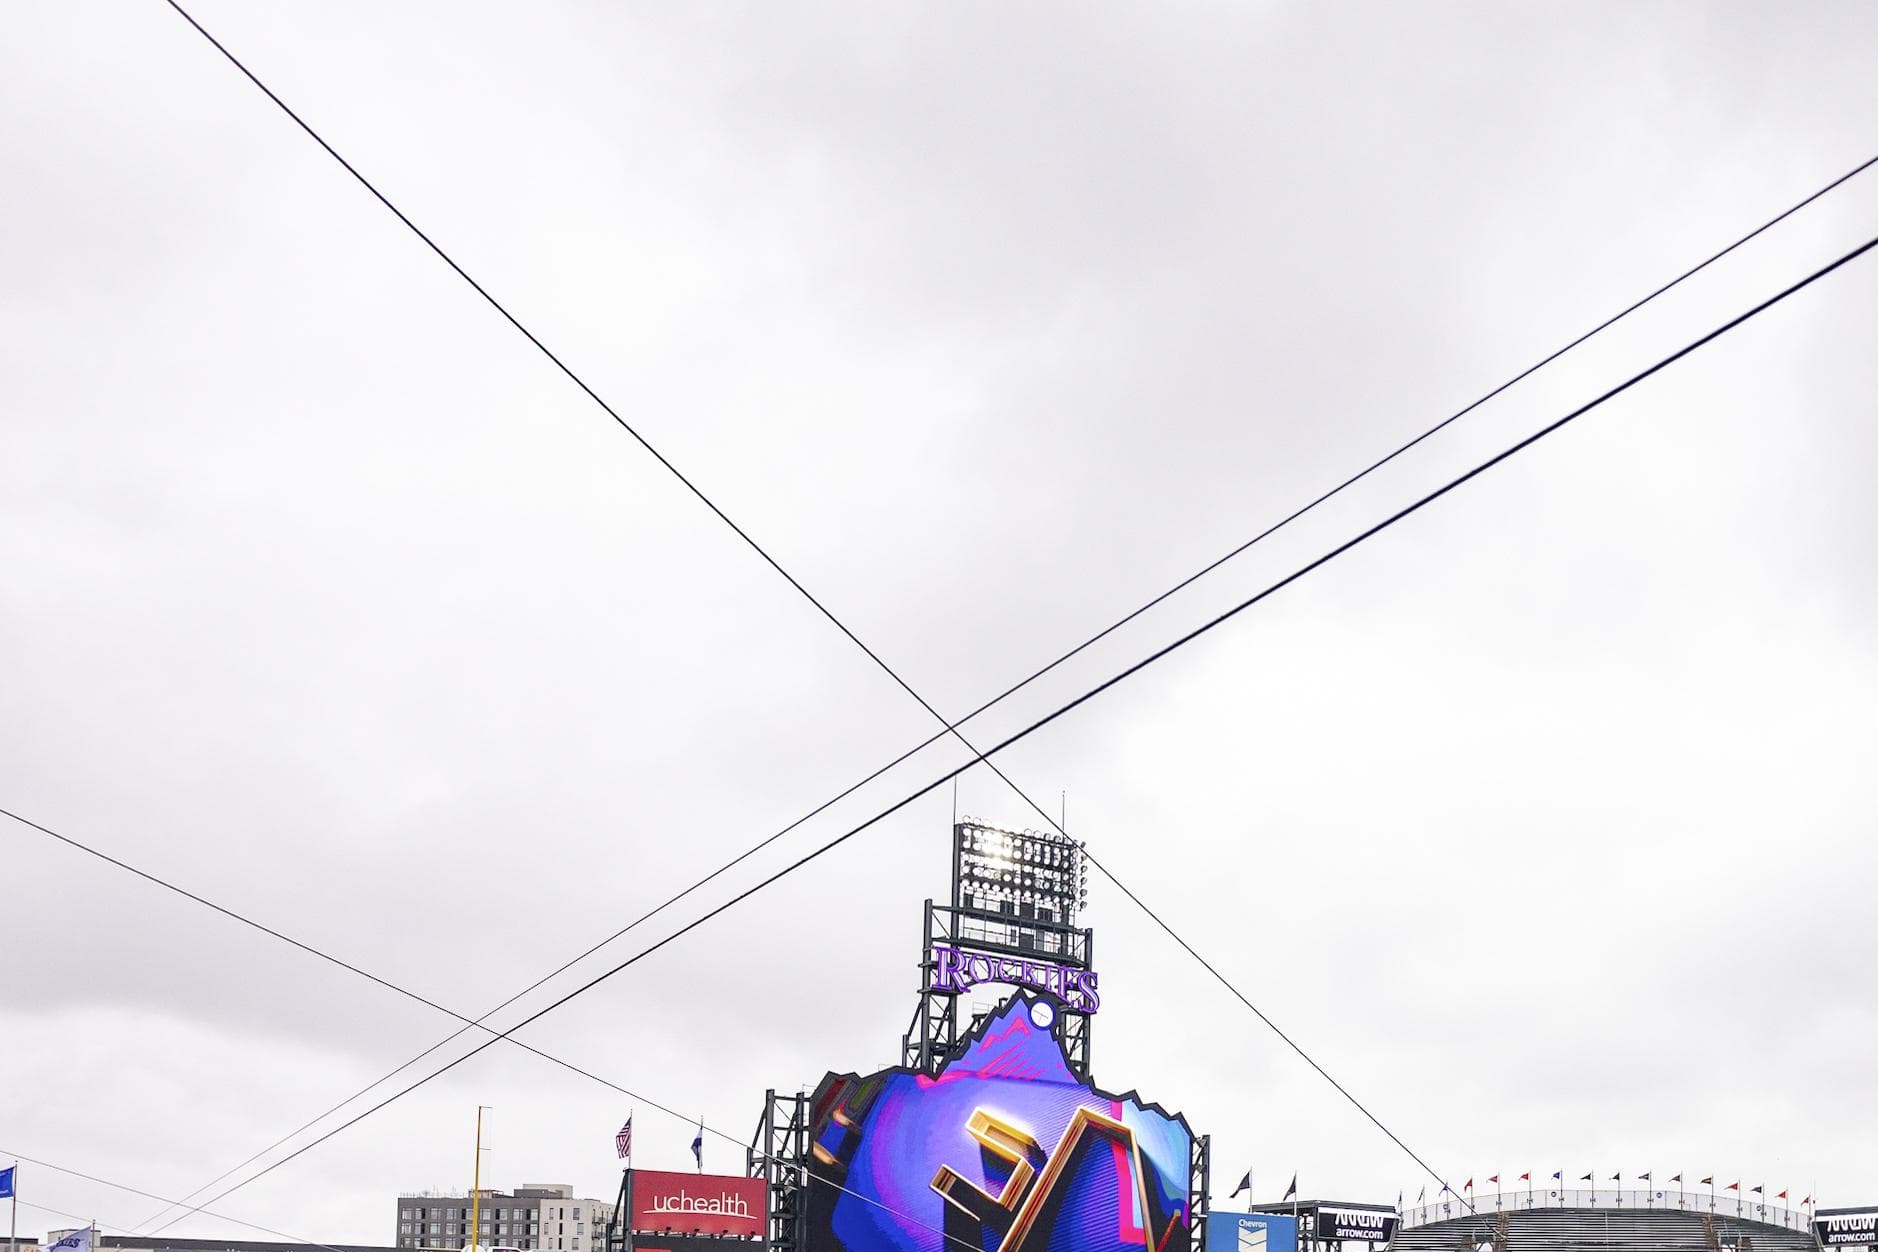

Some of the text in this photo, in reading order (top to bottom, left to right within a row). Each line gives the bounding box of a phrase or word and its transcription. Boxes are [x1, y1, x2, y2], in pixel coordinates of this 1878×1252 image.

[933, 946, 1099, 1014] ROCKIES
[653, 1189, 748, 1217] uchealth
[1239, 1218, 1267, 1228] Chevron
[1336, 1228, 1384, 1240] arrow.com
[1828, 1232, 1875, 1243] arrow.com
